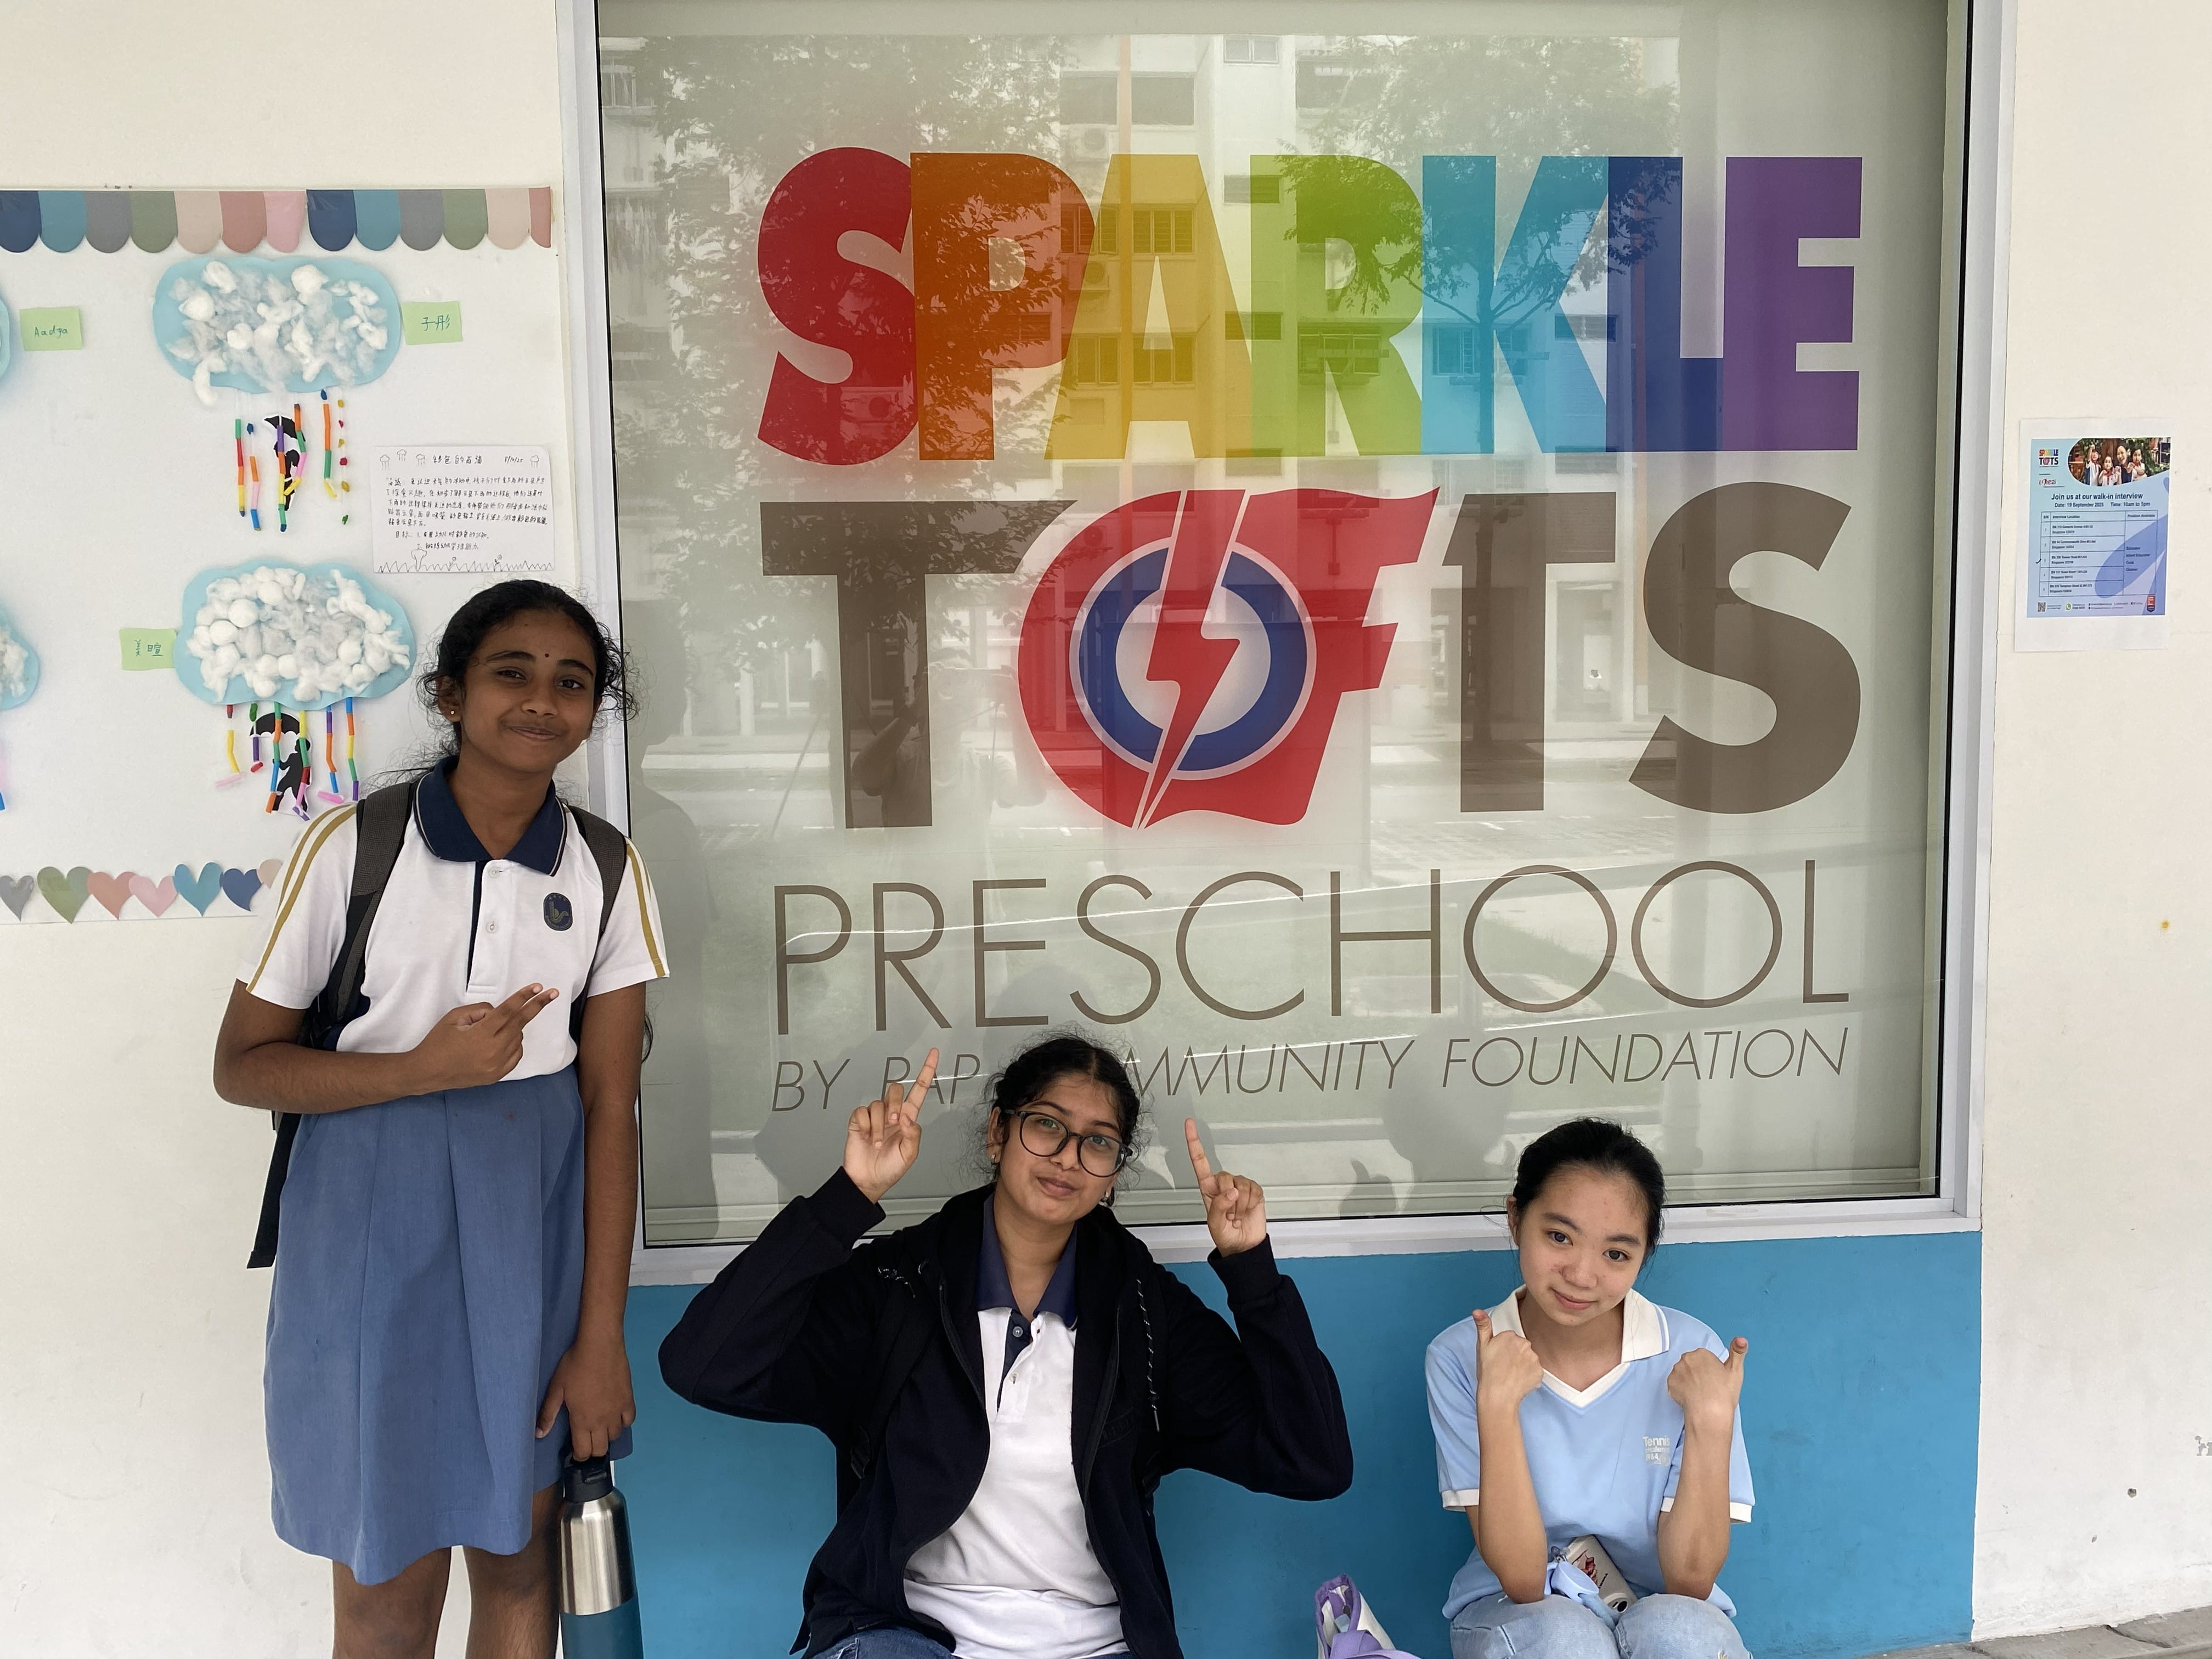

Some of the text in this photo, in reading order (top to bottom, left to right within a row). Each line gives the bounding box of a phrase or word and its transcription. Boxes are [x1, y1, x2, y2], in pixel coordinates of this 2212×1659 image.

[757, 146, 1863, 466] SPARKLE
[760, 481, 1861, 830] TOTS
[774, 859, 1849, 1035] PRESCHOOL
[771, 1058, 851, 1112] BY
[1122, 1039, 1415, 1097] MMUNITY
[1442, 1026, 1849, 1088] FOUNDATION
[1642, 1435, 1671, 1447] Tennis
